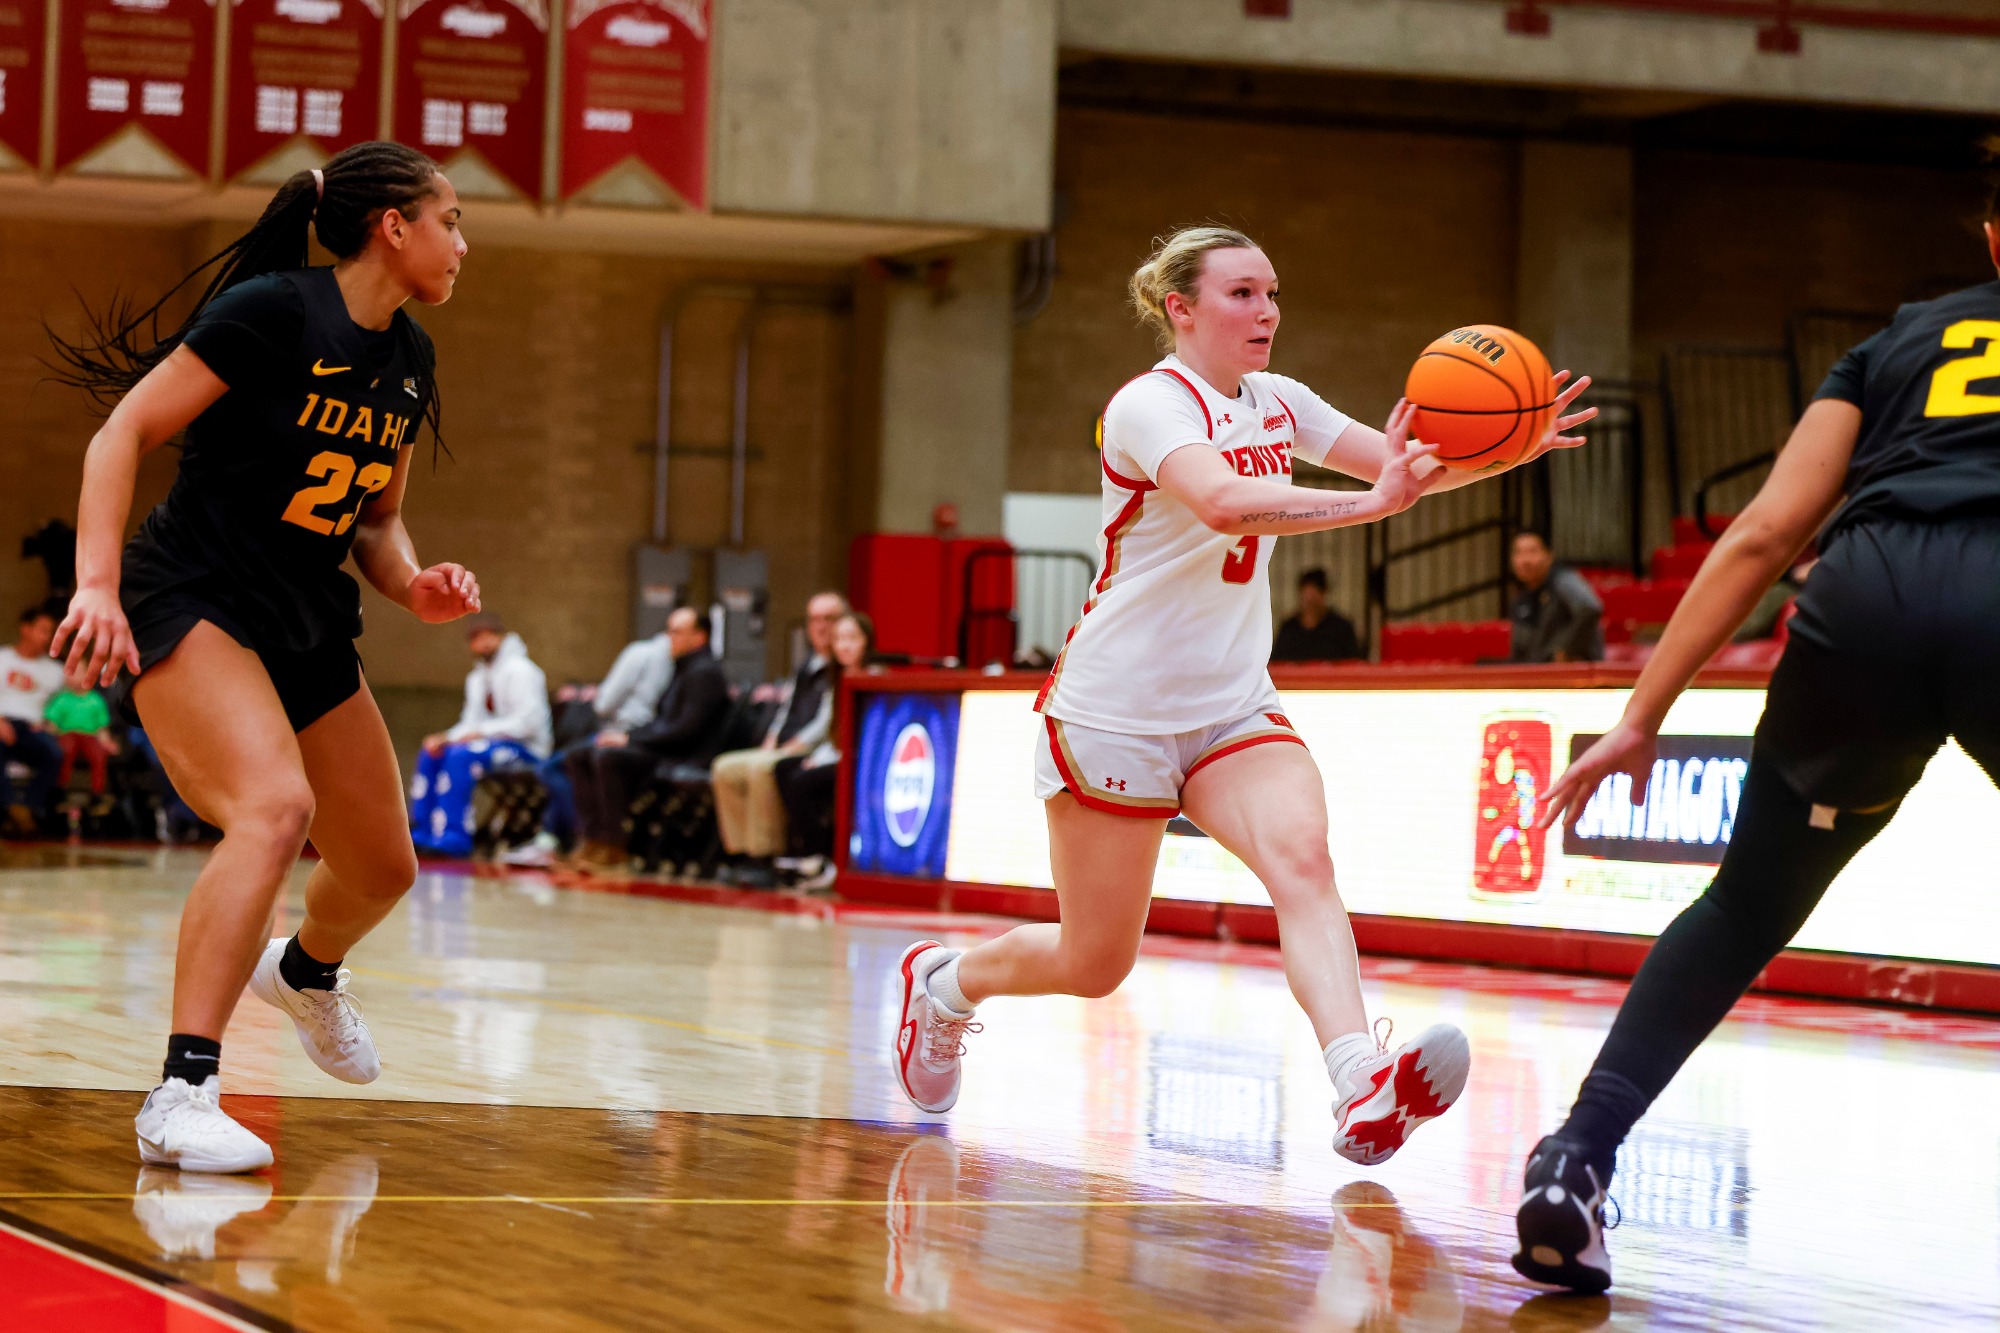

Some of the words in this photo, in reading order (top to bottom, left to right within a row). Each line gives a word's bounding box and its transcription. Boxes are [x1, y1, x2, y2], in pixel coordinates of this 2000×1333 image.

[1923, 319, 2000, 418] 2
[297, 392, 409, 450] IDAH
[1220, 441, 1293, 477] ENVE
[281, 450, 392, 535] 23
[1279, 507, 1327, 520] Proverbs
[1331, 502, 1357, 515] 17:17
